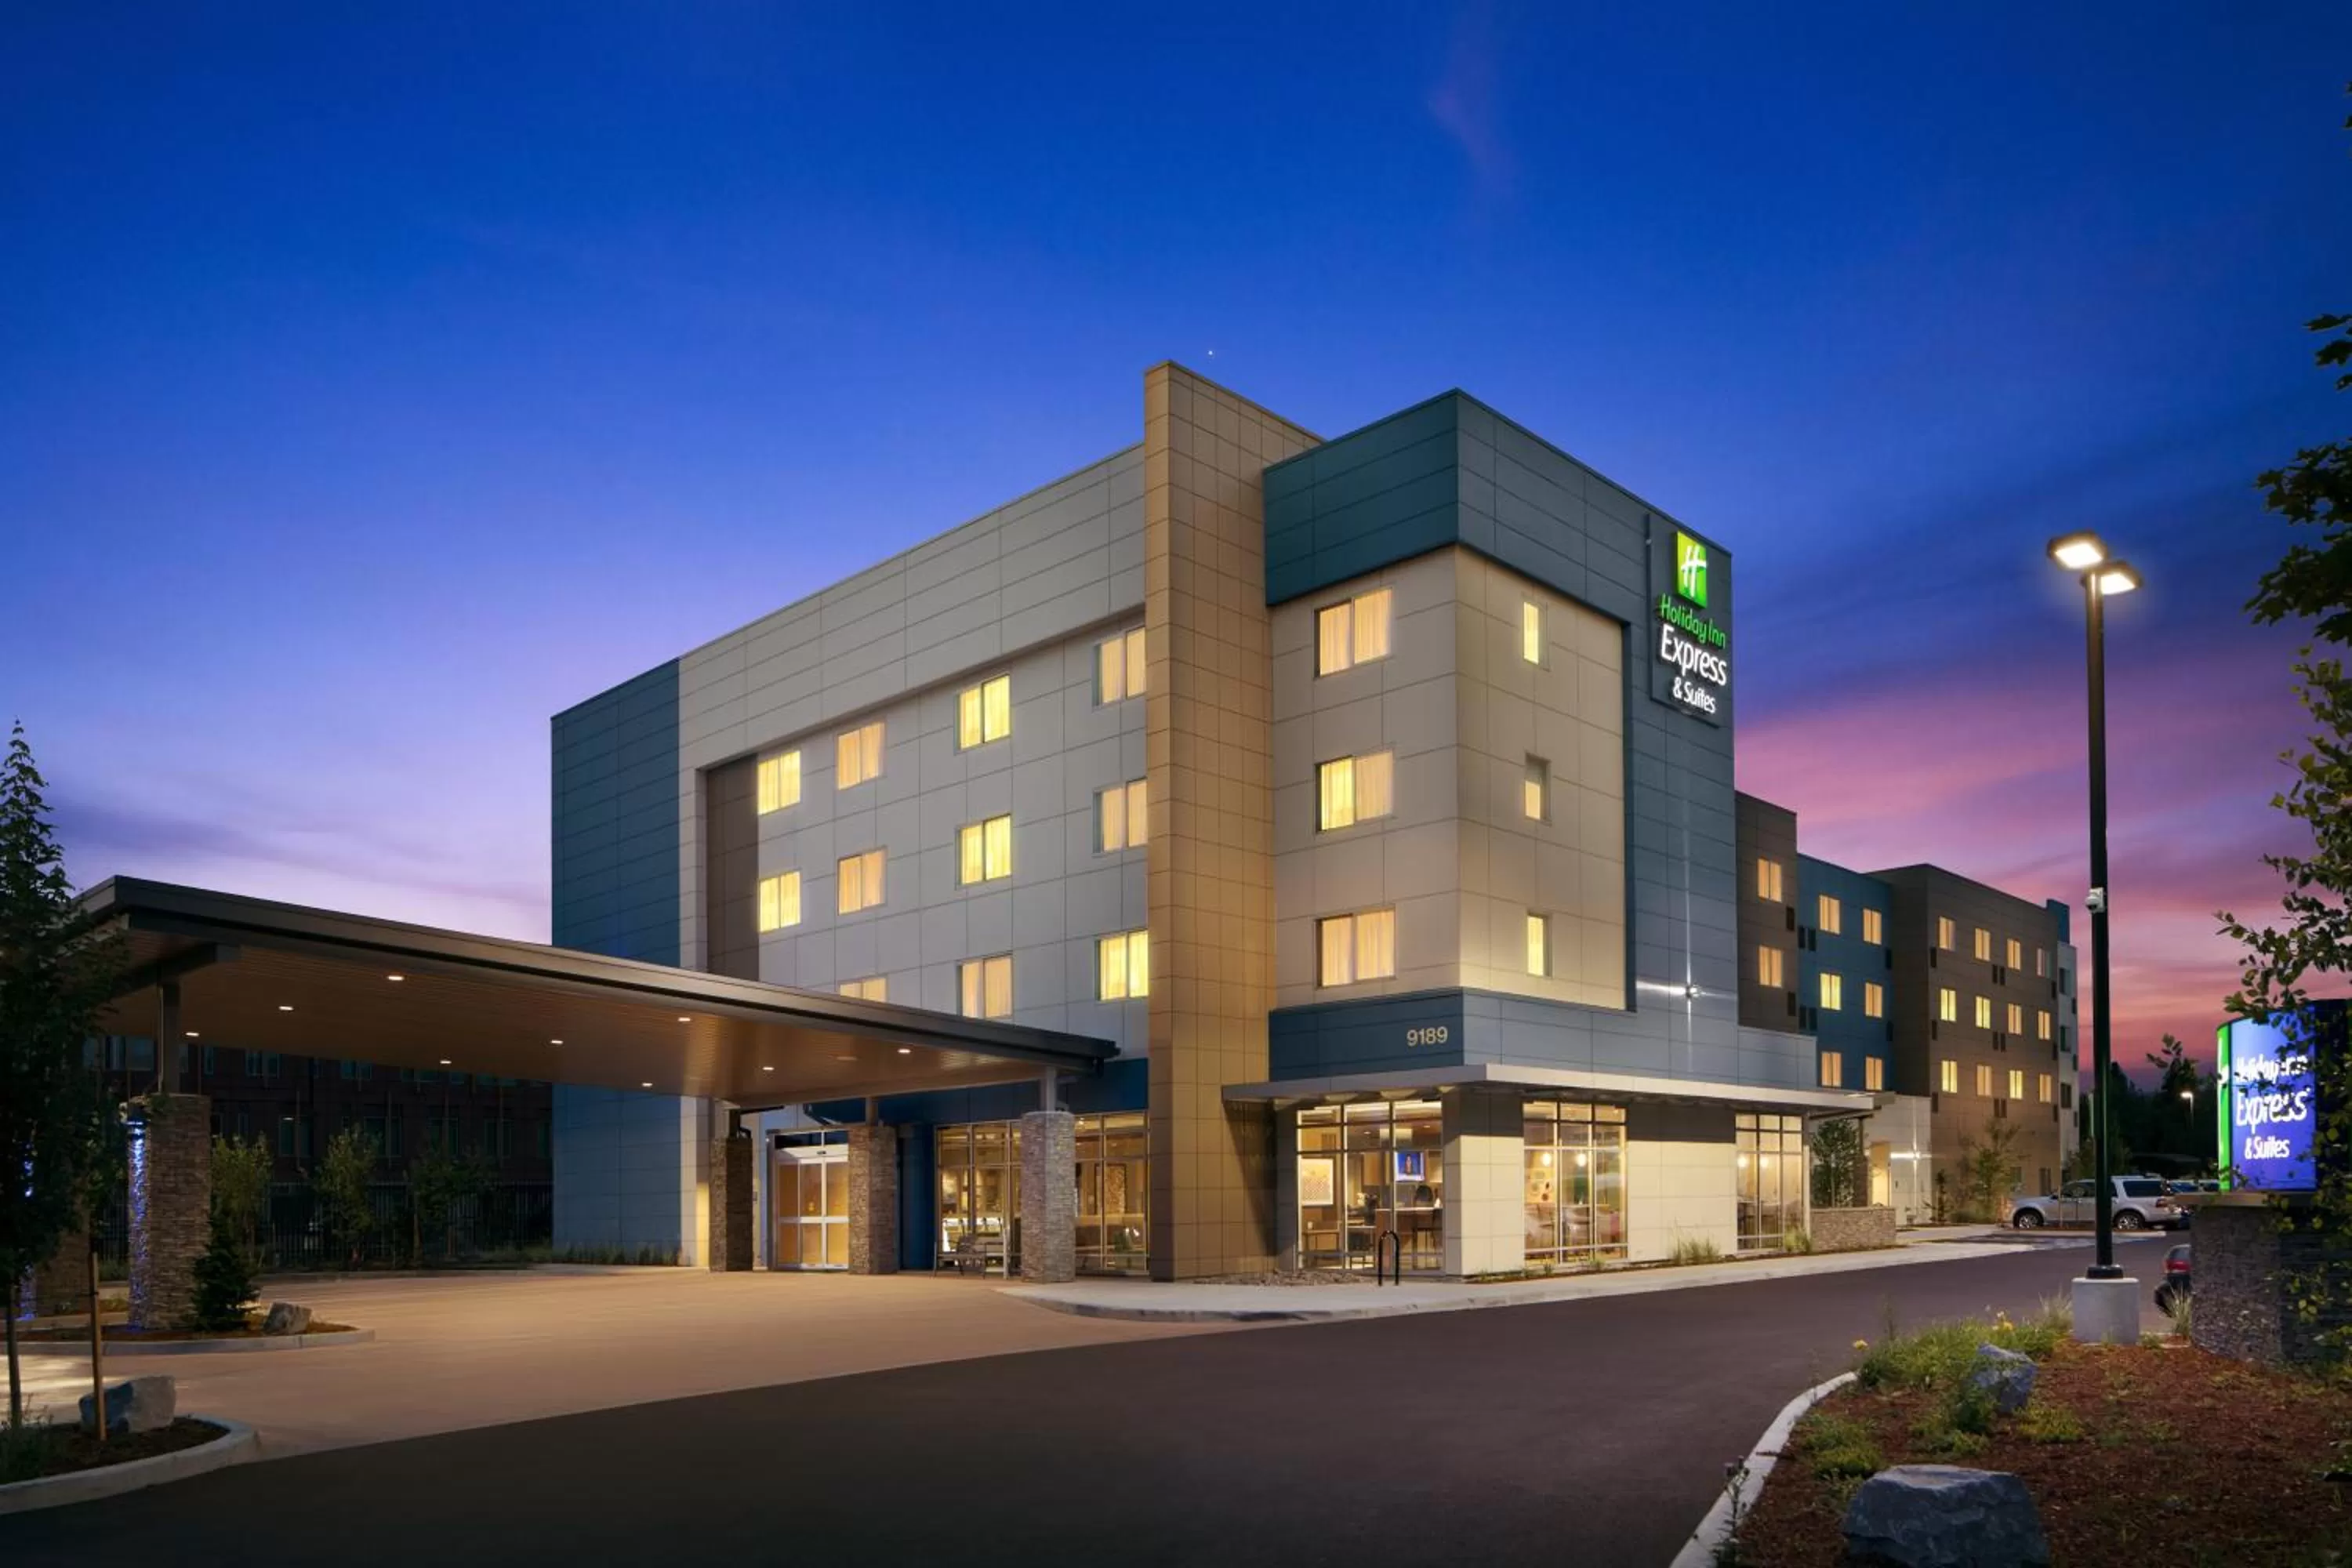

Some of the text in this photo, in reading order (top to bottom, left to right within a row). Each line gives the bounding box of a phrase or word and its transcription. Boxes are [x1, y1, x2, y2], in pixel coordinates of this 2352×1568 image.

[1661, 593, 1726, 649] Holiday Inn
[1661, 623, 1726, 686] Express
[1673, 677, 1716, 714] & Suites
[1406, 1025, 1448, 1047] 9189
[2253, 1136, 2290, 1160] Suites
